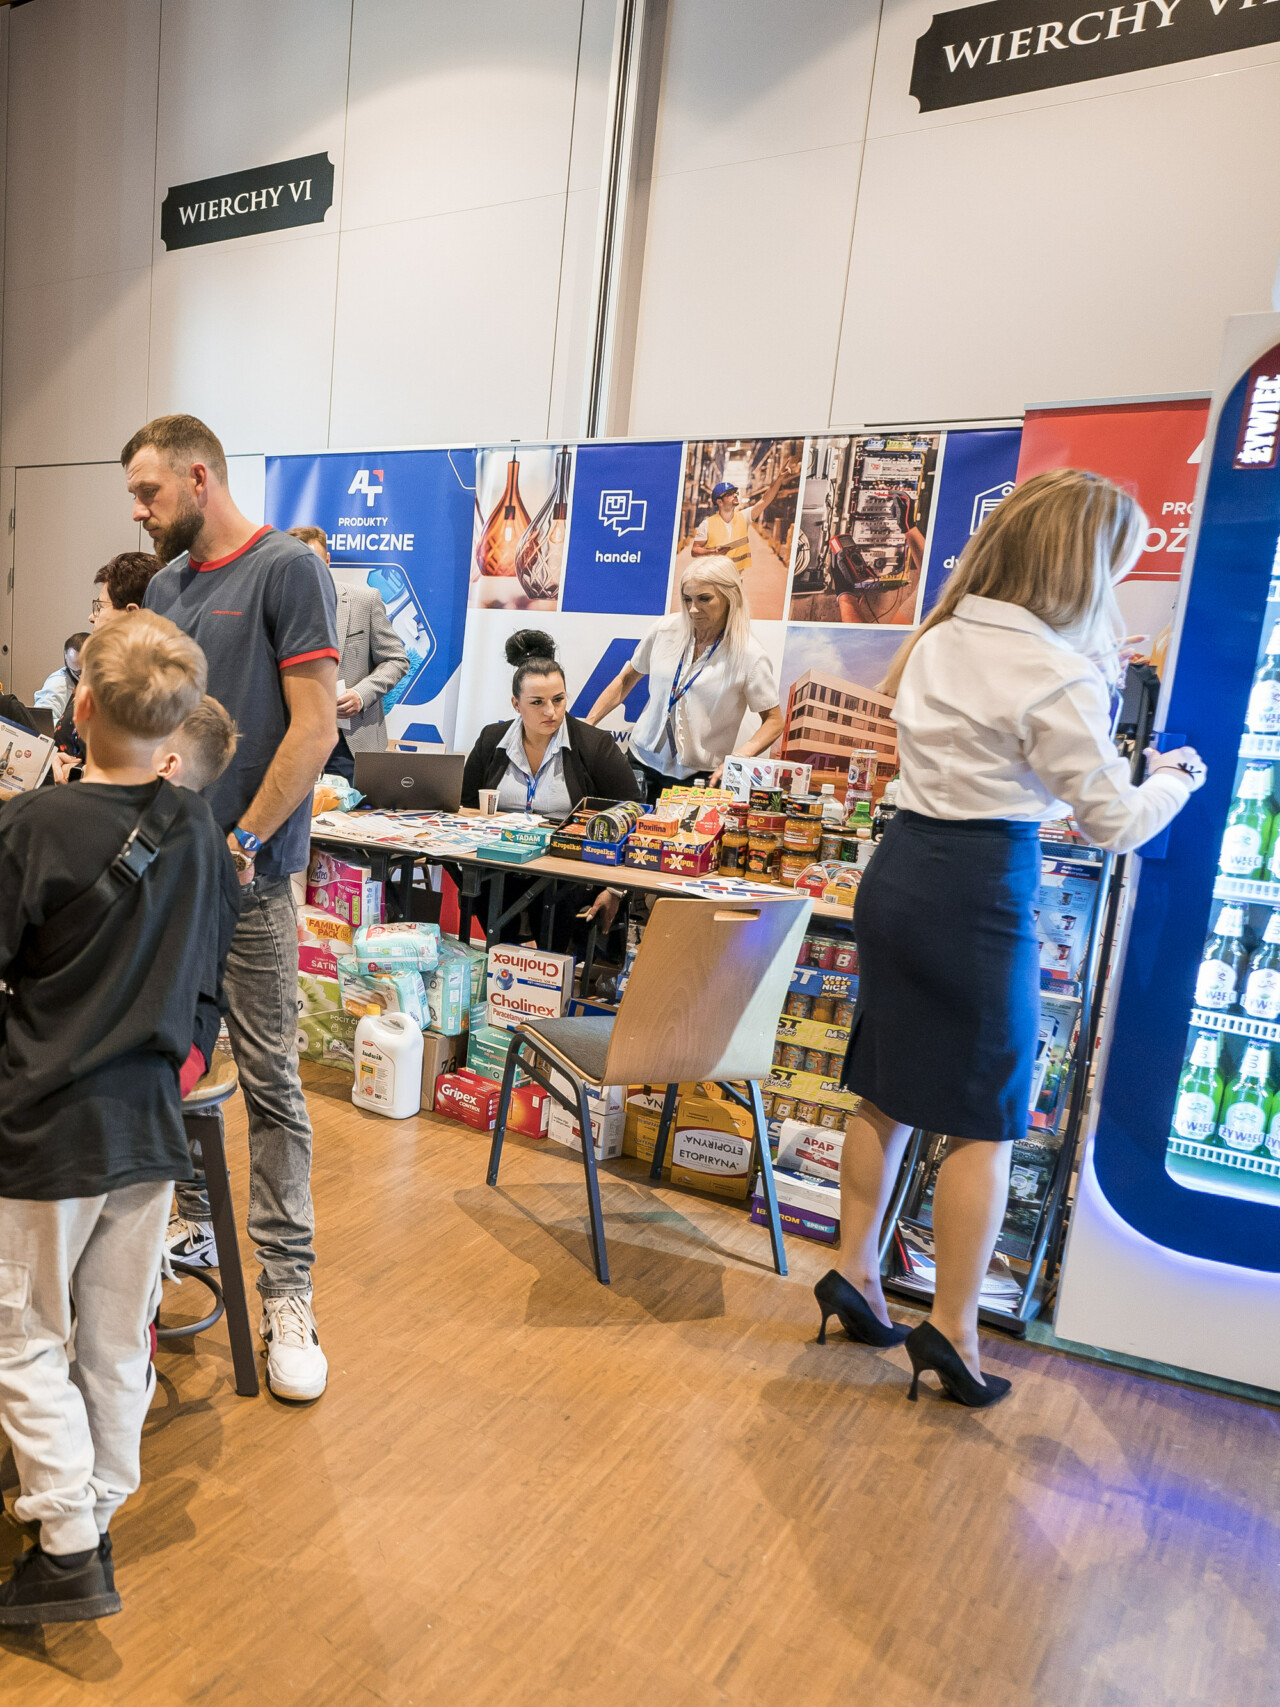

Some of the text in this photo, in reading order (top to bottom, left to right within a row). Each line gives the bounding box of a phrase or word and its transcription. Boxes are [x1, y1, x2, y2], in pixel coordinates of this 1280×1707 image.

[942, 0, 1182, 73] WIERCHY
[178, 179, 312, 226] WIERCHY VI
[338, 517, 388, 527] PRODUKTY
[326, 533, 415, 551] HEMICZNE
[595, 550, 642, 564] handel
[638, 822, 667, 833] Poxilina
[515, 833, 540, 843] TADAM
[628, 848, 658, 866] POXIPOL
[664, 853, 695, 871] POXIPOL
[308, 919, 341, 932] FAMILY
[318, 928, 339, 939] PACK
[311, 960, 337, 972] SATIN
[493, 952, 559, 977] Cholinex
[490, 992, 555, 1018] Cholinex
[330, 1014, 349, 1024] POCIT
[441, 1083, 478, 1106] Gripex
[458, 1101, 481, 1113] CONTROL
[685, 1134, 744, 1156] ETOPIRYNA
[803, 1136, 835, 1152] APAP
[1013, 1140, 1047, 1152] CHRONA
[679, 1149, 737, 1170] ETOPIRYNA
[756, 1207, 829, 1232] IBROM SPRINT
